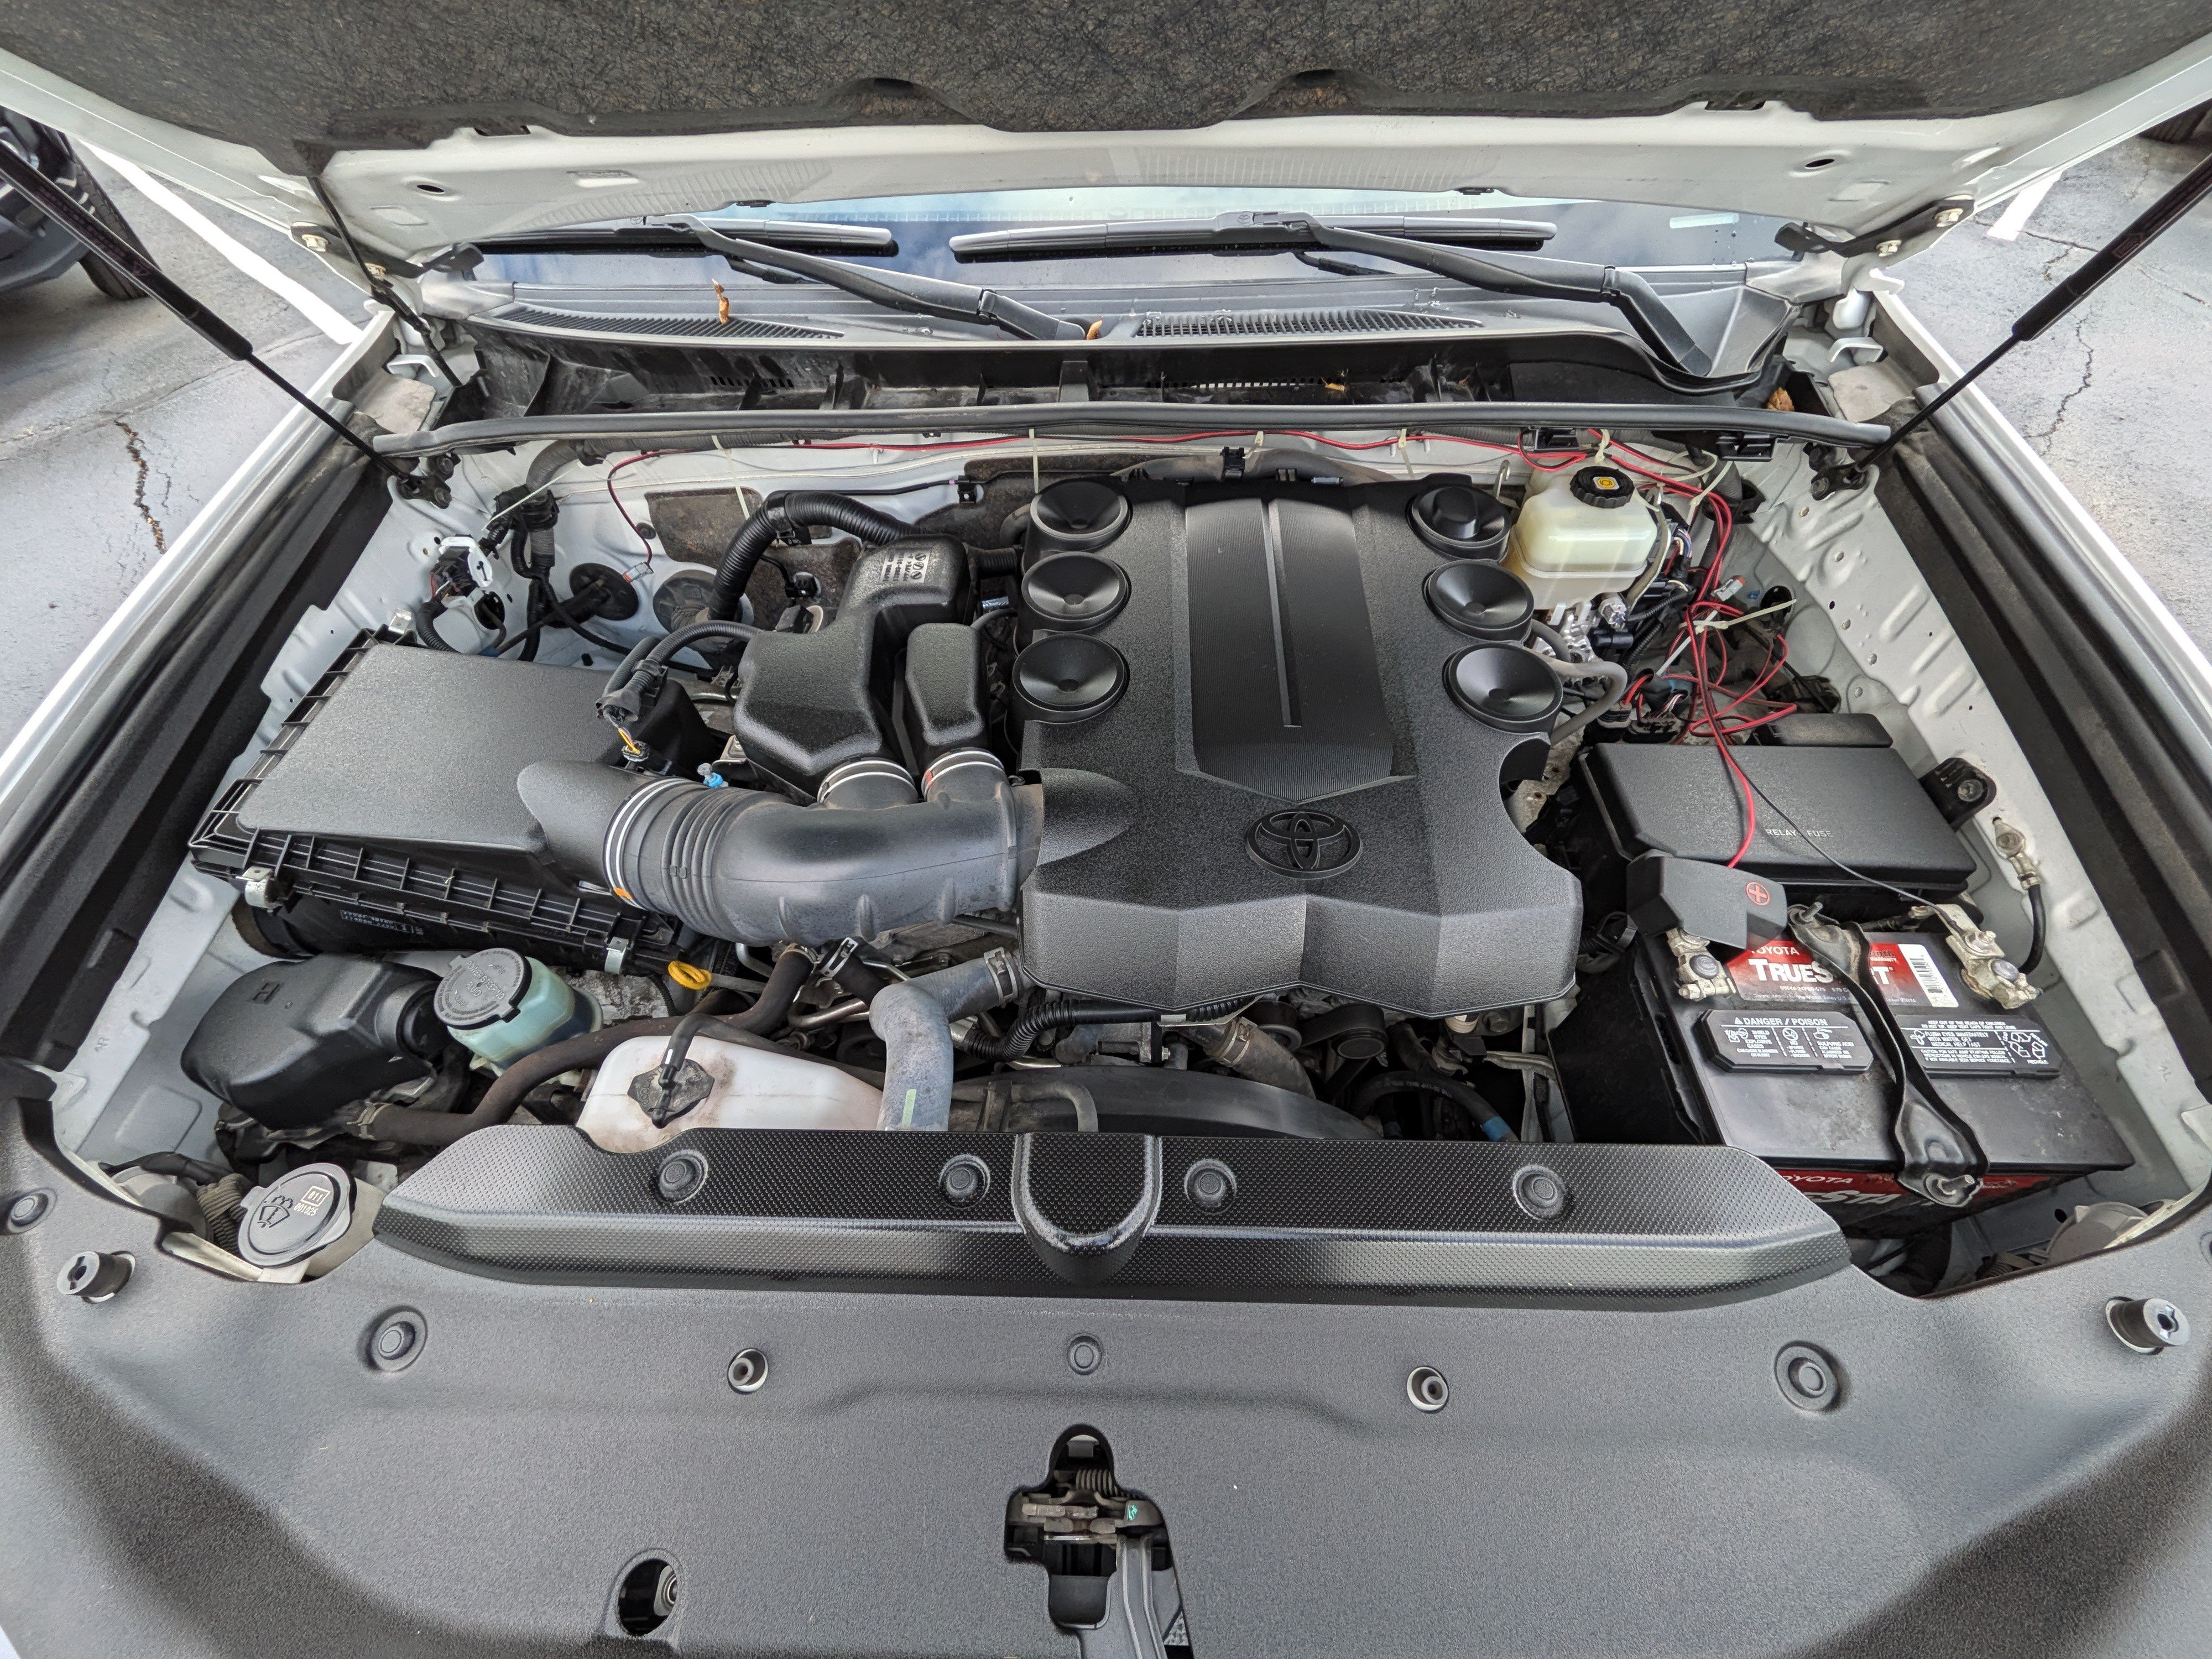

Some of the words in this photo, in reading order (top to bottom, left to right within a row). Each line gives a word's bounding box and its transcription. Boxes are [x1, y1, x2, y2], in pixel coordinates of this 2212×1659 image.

[465, 961, 484, 979] POWER
[481, 975, 505, 1000] STEERING
[465, 980, 482, 997] FLUID
[1743, 1018, 1783, 1026] DANGER
[294, 1202, 319, 1217] 001025
